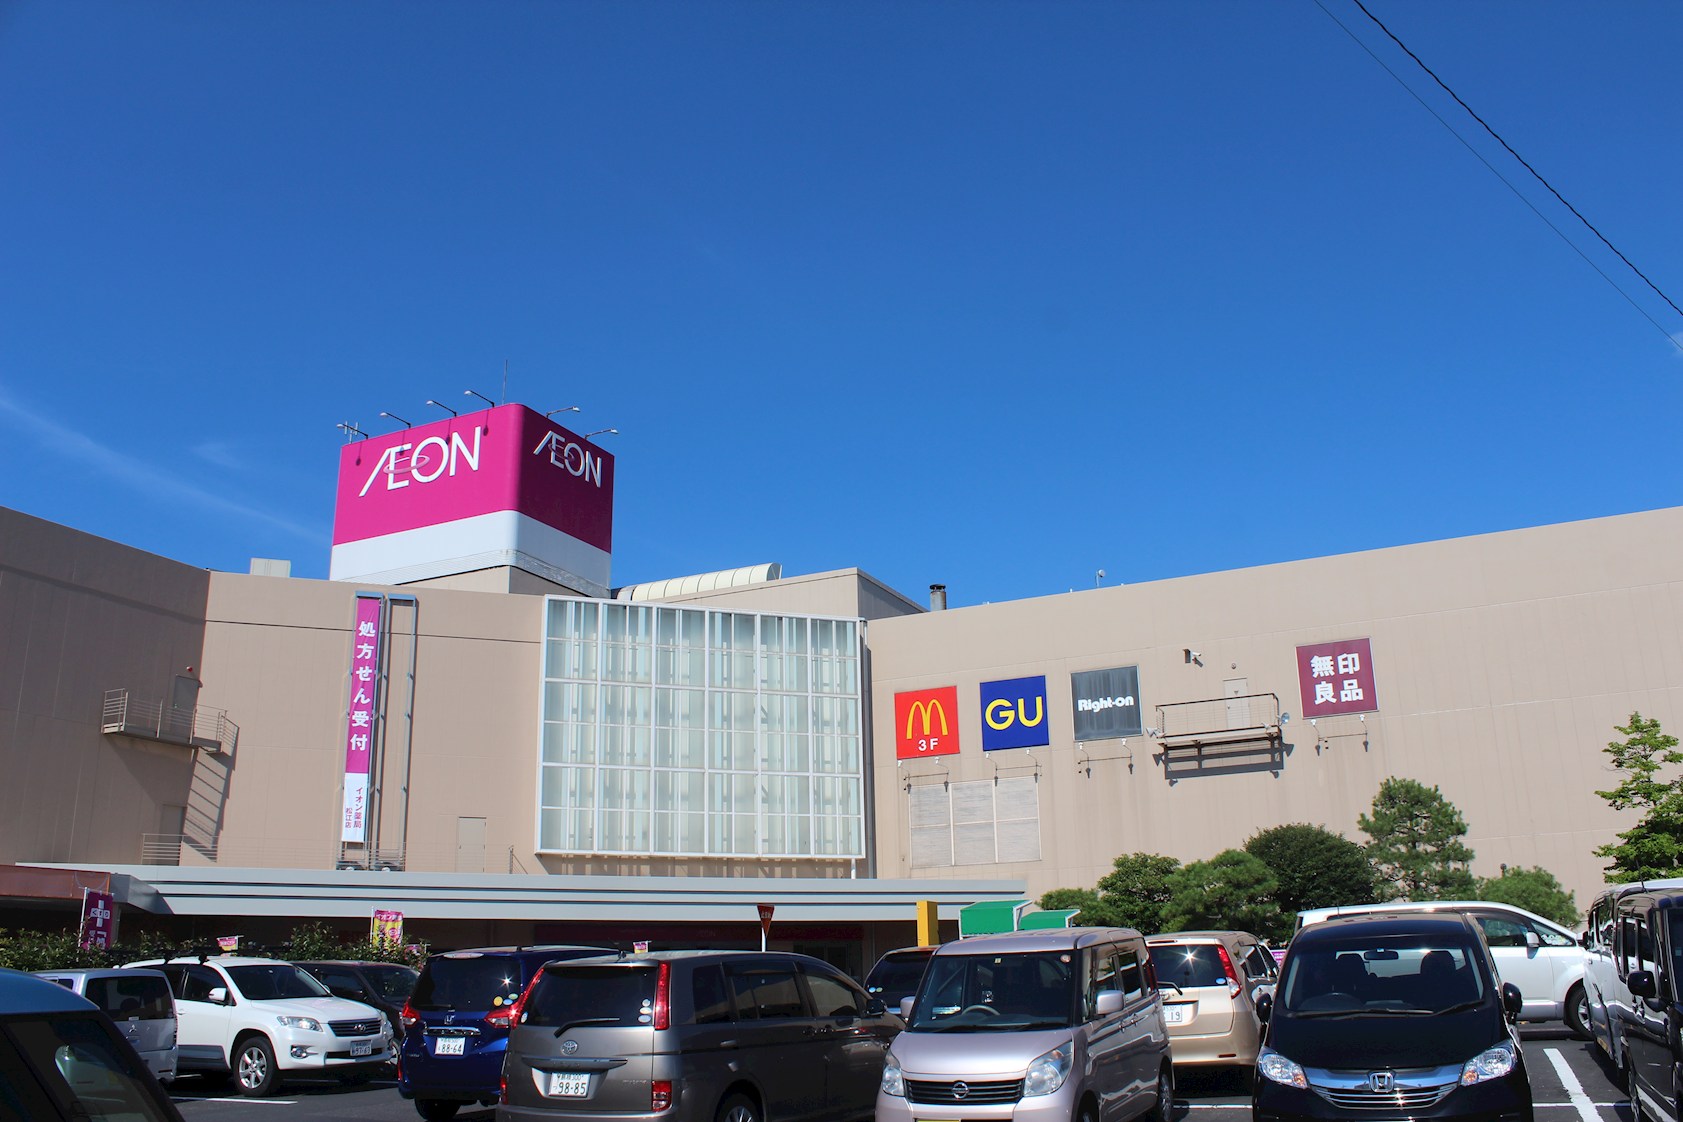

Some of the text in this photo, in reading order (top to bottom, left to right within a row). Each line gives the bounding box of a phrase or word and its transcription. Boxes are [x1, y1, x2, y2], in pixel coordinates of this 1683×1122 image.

[1310, 653, 1360, 678] 無印
[350, 620, 376, 751] 処方せん受付
[1314, 679, 1364, 705] 良品
[985, 695, 1044, 731] GU
[1077, 695, 1135, 713] Right-on
[558, 1081, 587, 1095] 98-85
